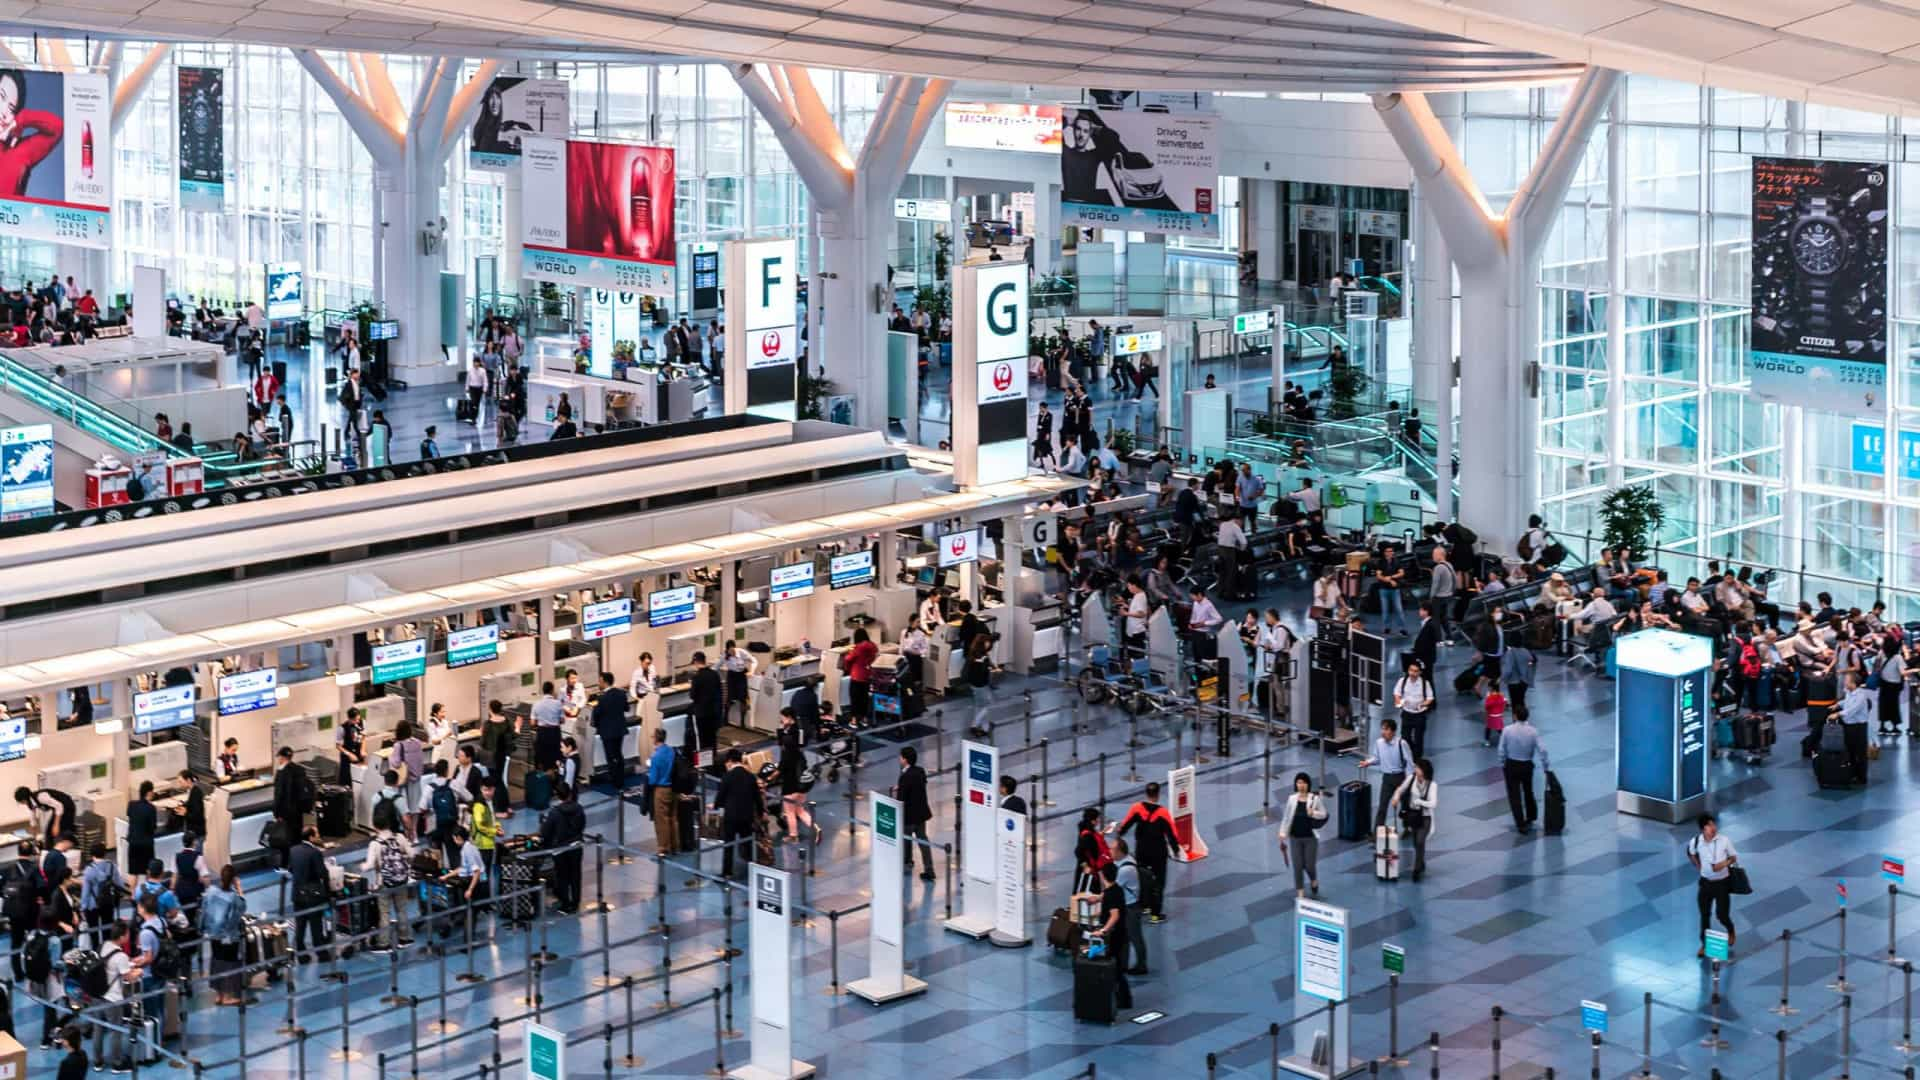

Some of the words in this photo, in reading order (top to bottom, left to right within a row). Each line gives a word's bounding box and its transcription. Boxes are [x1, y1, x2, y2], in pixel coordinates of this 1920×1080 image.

[1157, 127, 1187, 139] Driving
[56, 212, 88, 223] HANEDA
[1079, 211, 1120, 222] WORLD
[56, 219, 88, 231] TOKYO
[535, 261, 577, 275] WORLD
[616, 264, 651, 274] HANEDA
[616, 271, 651, 281] TOKYO
[762, 257, 781, 307] F
[616, 280, 651, 288] JAPAN
[986, 282, 1017, 336] G
[1800, 336, 1835, 347] CITIZEN
[1754, 360, 1805, 374] WORLD
[1033, 520, 1047, 543] G
